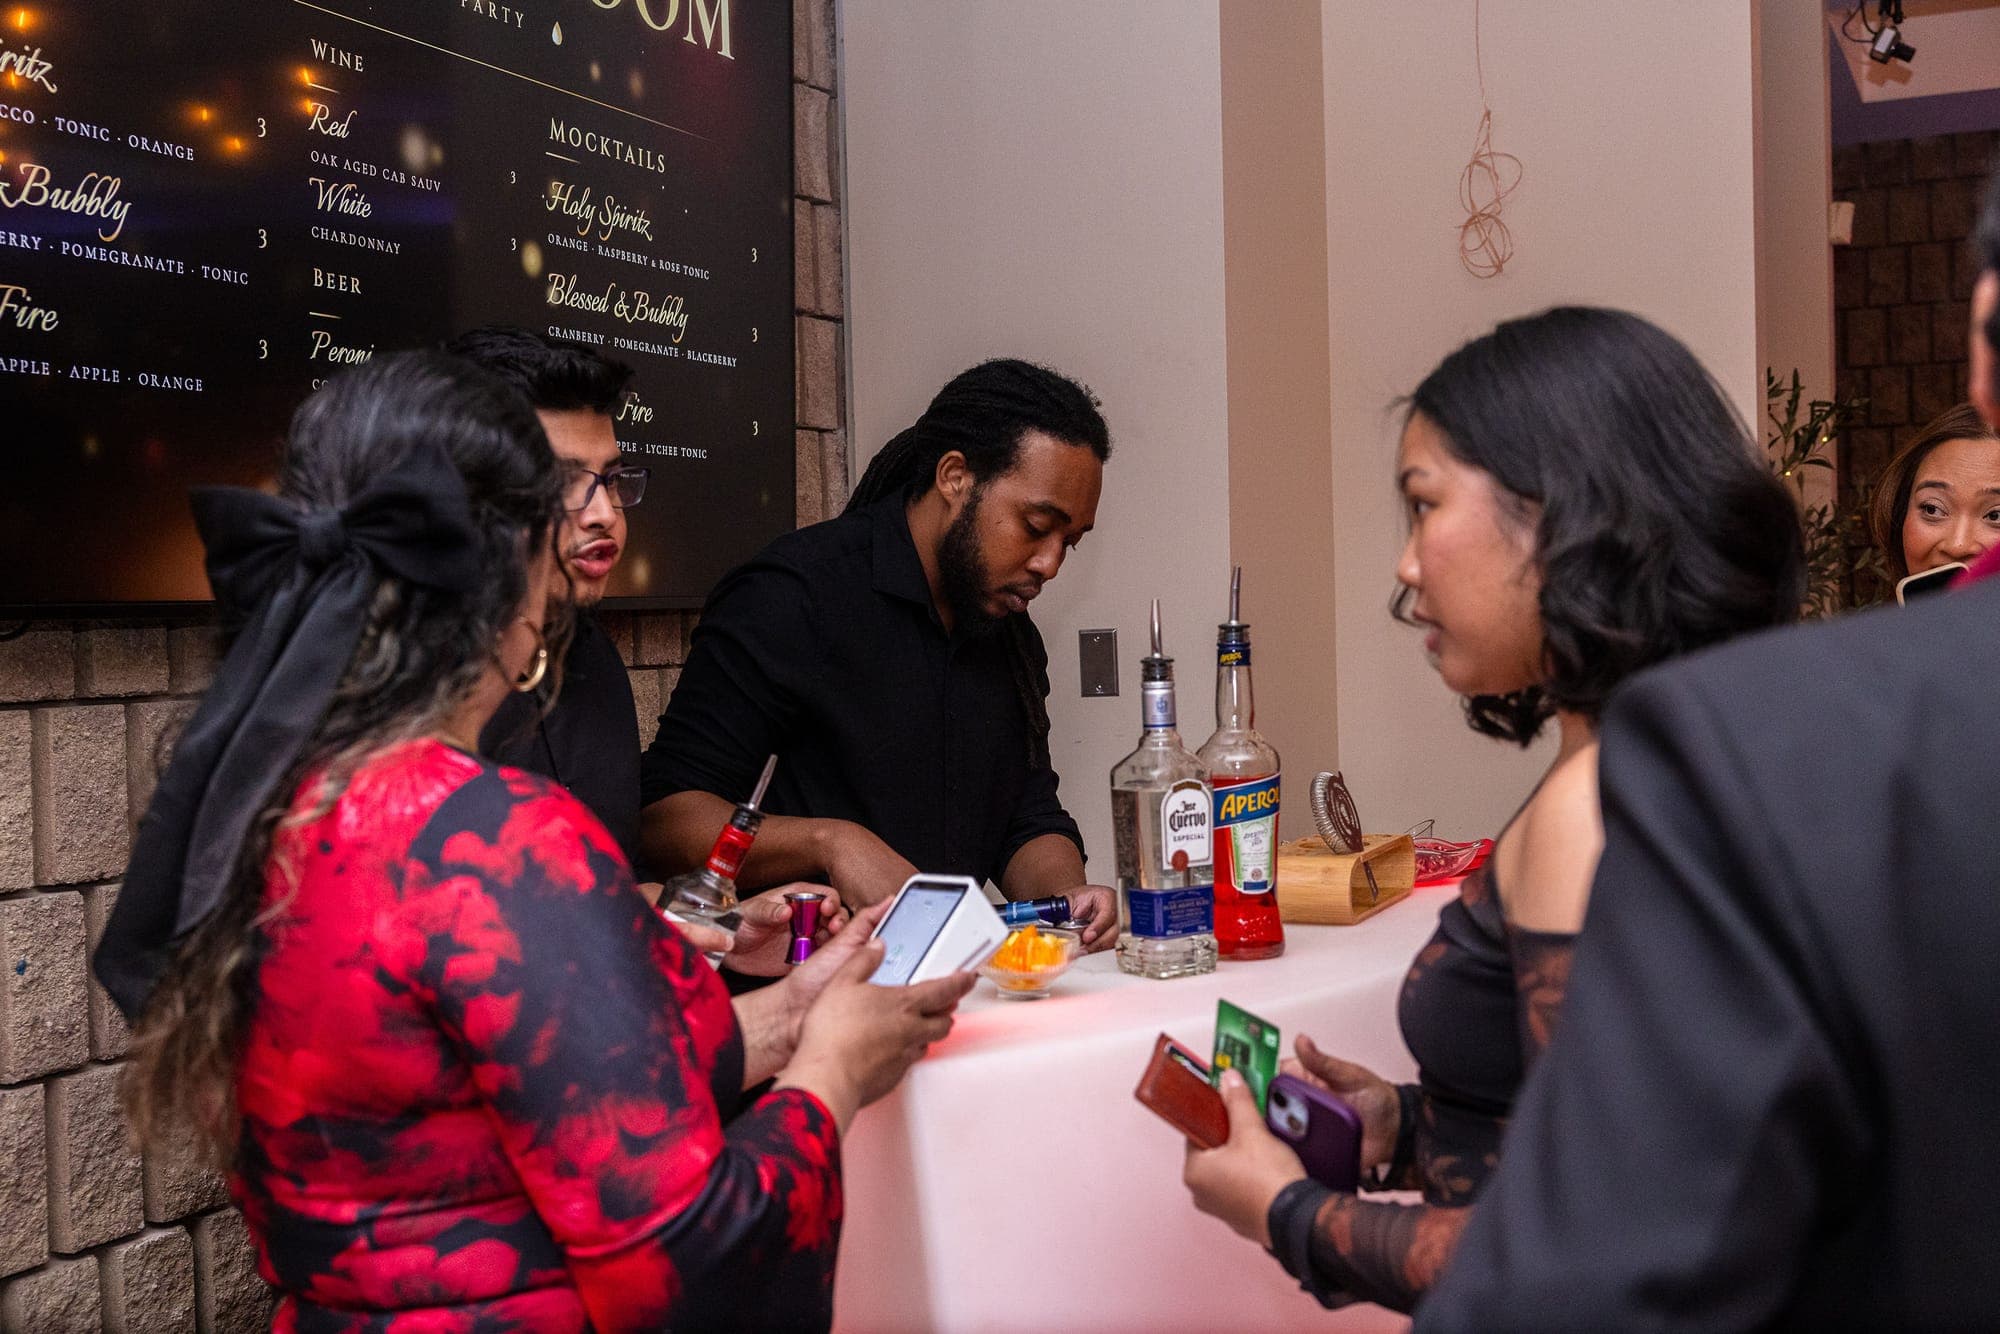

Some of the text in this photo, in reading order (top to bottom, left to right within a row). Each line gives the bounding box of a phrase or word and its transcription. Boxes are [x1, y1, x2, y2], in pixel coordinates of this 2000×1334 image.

[590, 0, 735, 60] OM
[0, 38, 58, 94] ritz
[310, 38, 365, 73] WINE
[257, 117, 267, 138] 3
[308, 102, 358, 139] Red
[54, 116, 110, 142] TONIC
[128, 134, 195, 161] ORANGE
[549, 117, 666, 174] MOCKTAILS
[310, 150, 442, 193] OAK AGED CAB SAUV
[510, 170, 517, 185] 3
[308, 177, 373, 218] White
[545, 181, 653, 242] Holy Spiritz
[258, 228, 268, 249] 3
[311, 226, 401, 255] CHARDONNAY
[511, 237, 517, 252] 3
[751, 247, 758, 264] 3
[61, 241, 184, 275] POMEGRANATE
[201, 265, 249, 286] TONIC
[547, 233, 588, 252] ORANGE
[598, 245, 649, 266] RASPBERRY
[659, 259, 681, 274] ROSE
[683, 265, 710, 281] TONIC
[313, 267, 362, 295] BEER
[546, 273, 617, 314] Blessed
[0, 284, 59, 332] Fire
[258, 339, 268, 360] 3
[309, 331, 375, 366] Peroni
[548, 325, 738, 368] CRANBERRY POMEGRANATE BLACKBERRY
[751, 327, 759, 344] 3
[69, 364, 120, 384] APPLE
[138, 372, 203, 393] ORANGE
[615, 391, 654, 424] Fire
[752, 420, 759, 436] 3
[646, 443, 678, 457] LYCHEE
[681, 447, 708, 459] TONIC
[1169, 809, 1206, 832] Cuervo
